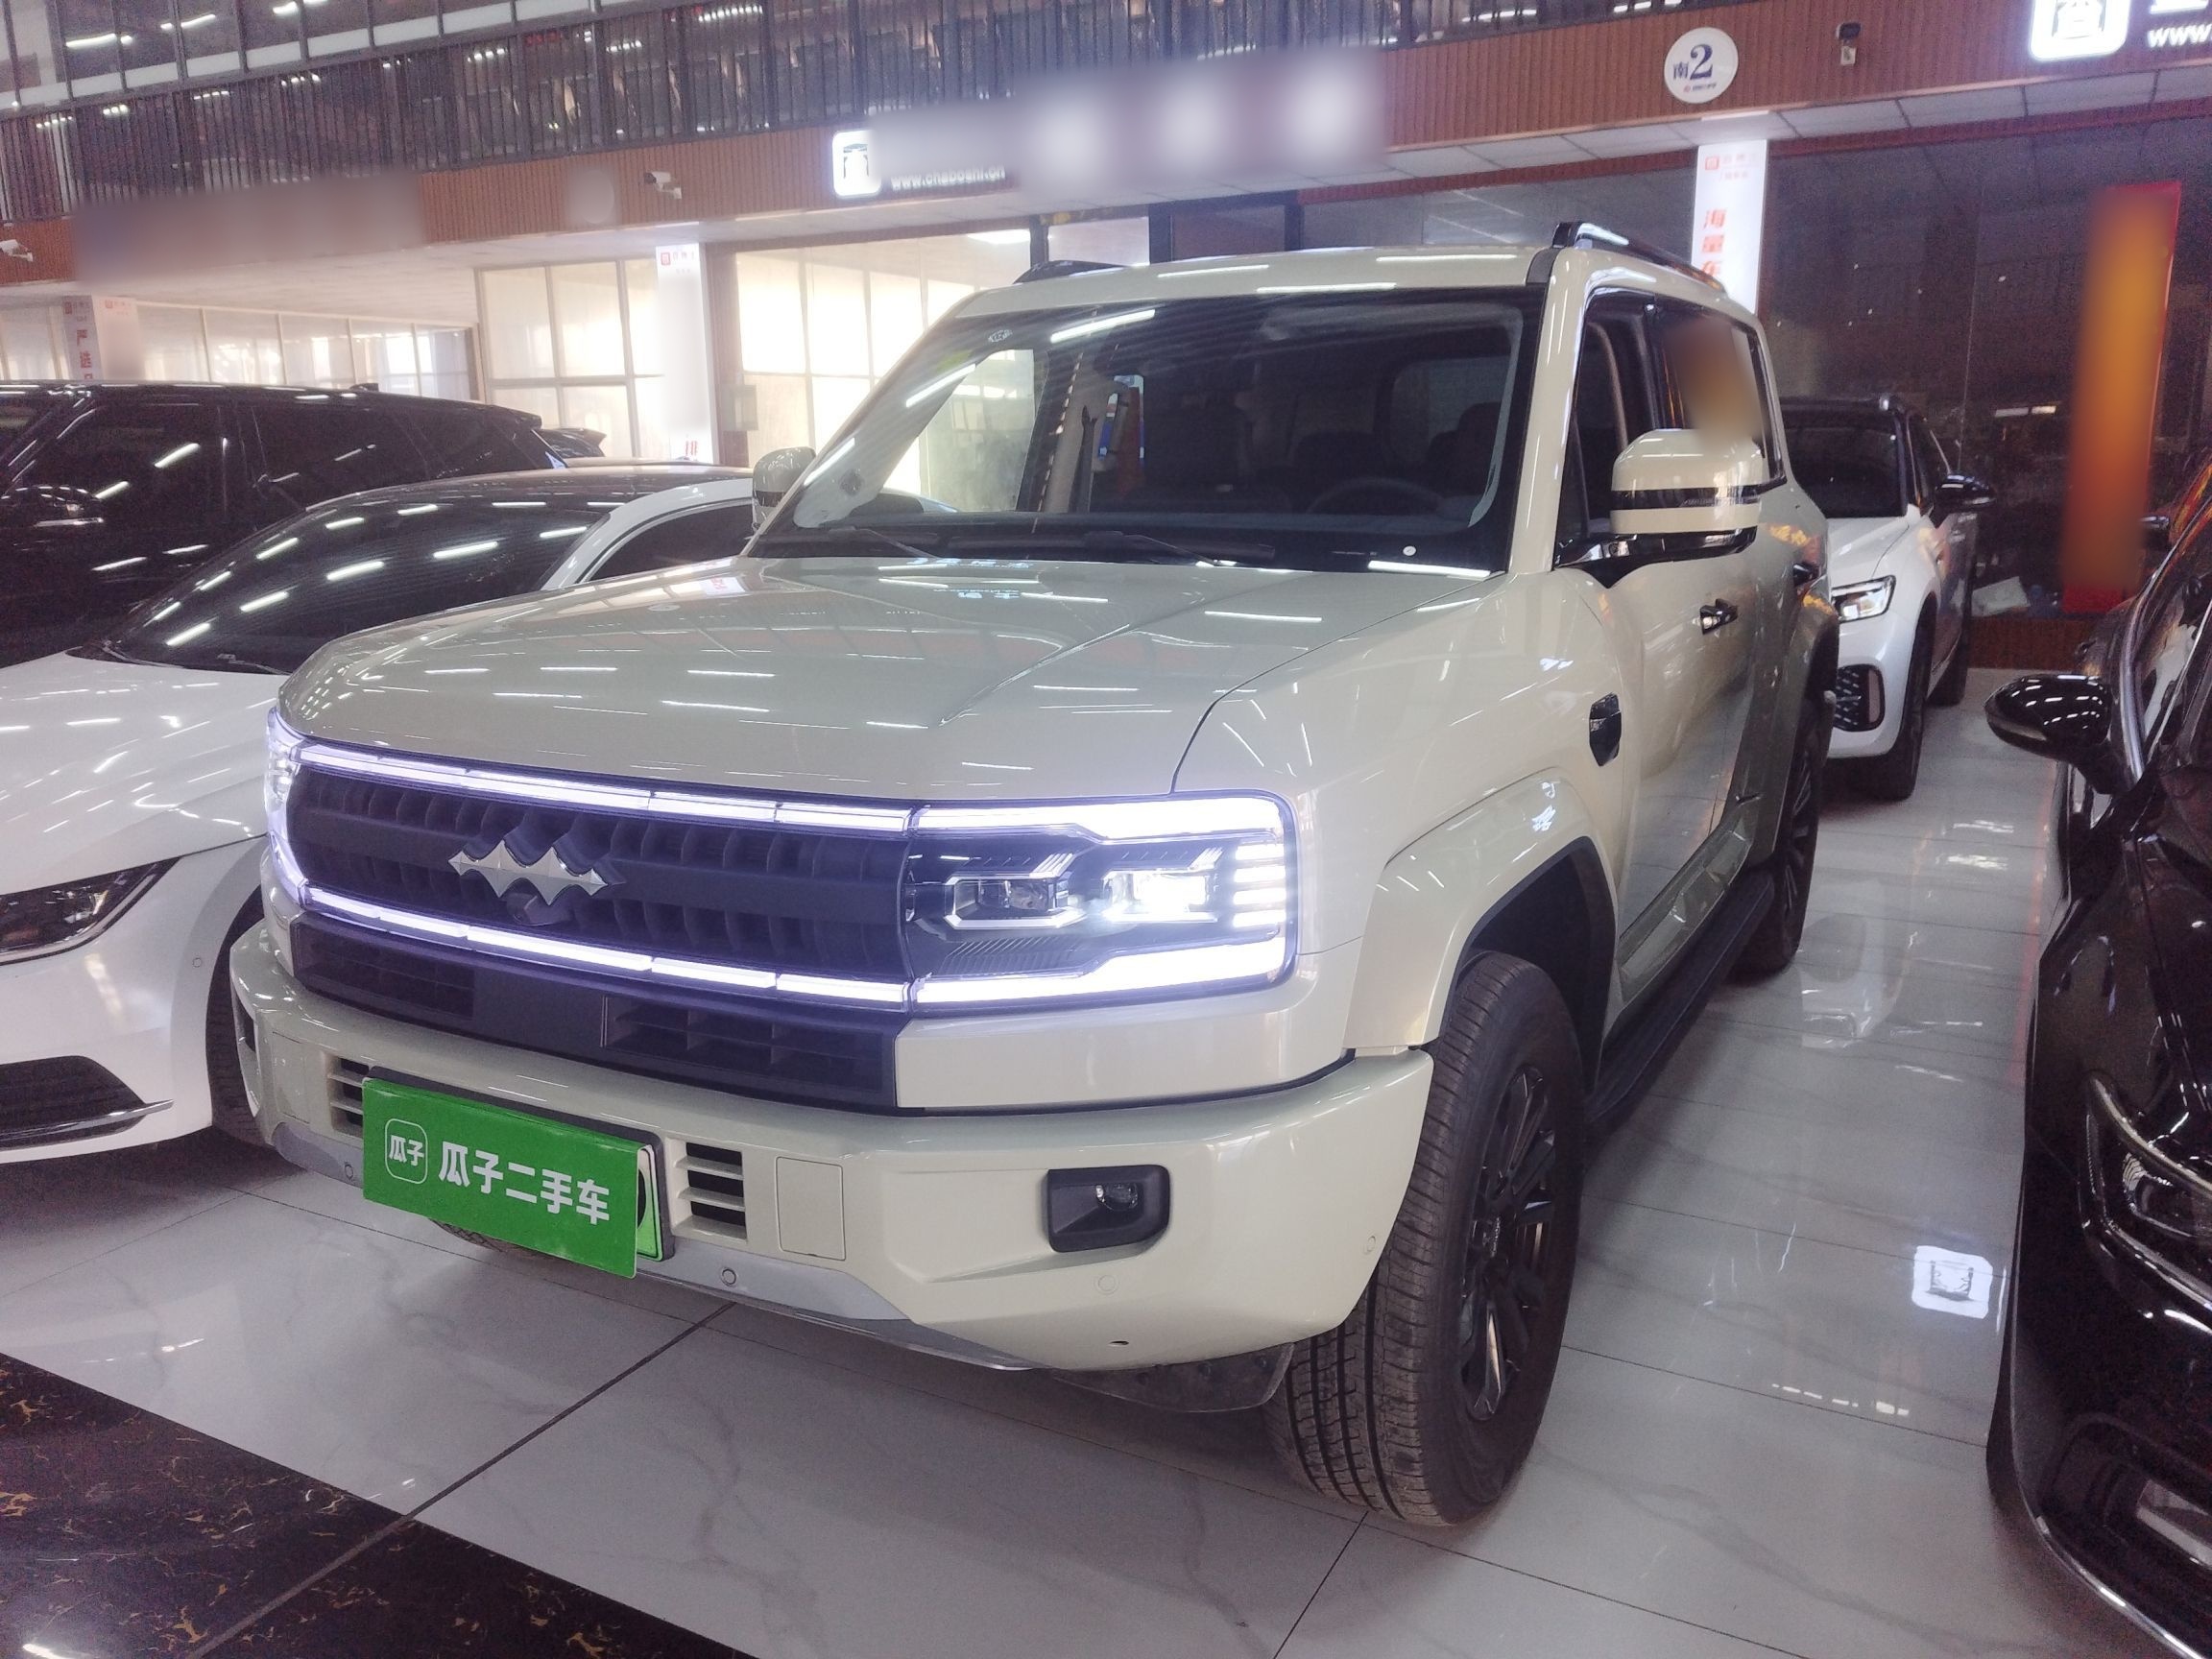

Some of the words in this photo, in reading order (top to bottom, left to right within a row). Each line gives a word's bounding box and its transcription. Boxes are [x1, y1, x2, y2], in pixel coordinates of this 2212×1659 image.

[389, 1134, 424, 1166] 瓜子
[438, 1141, 610, 1225] 瓜子二手车
